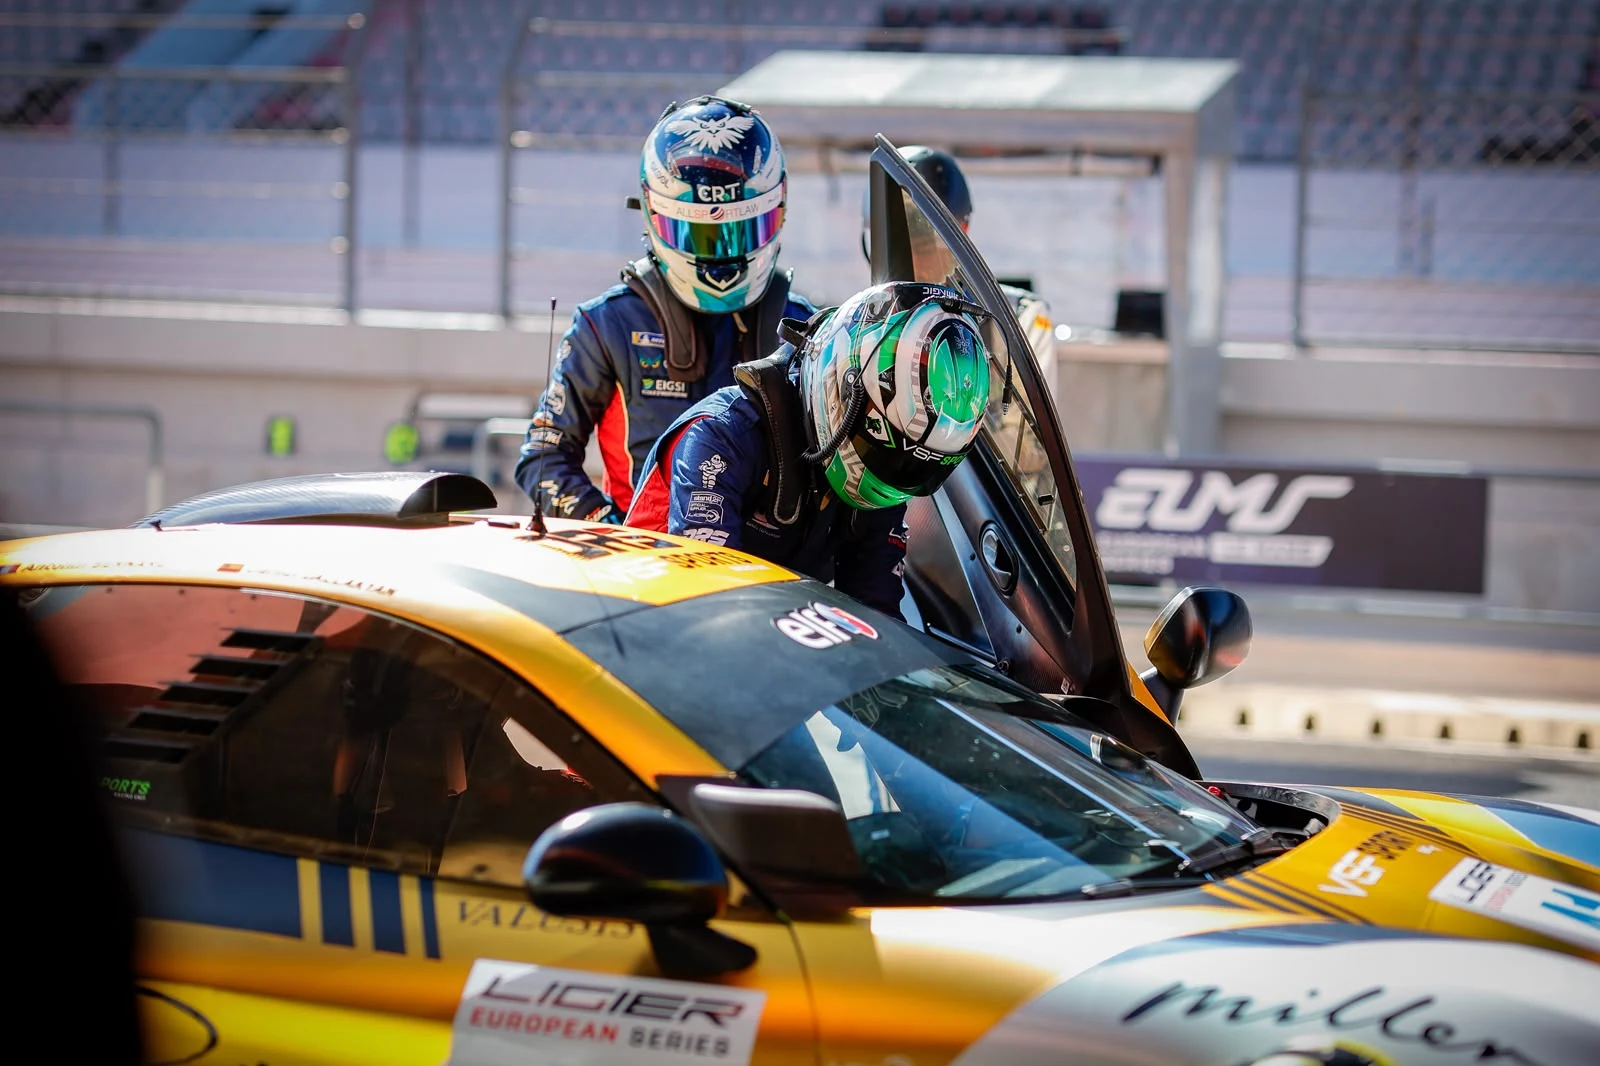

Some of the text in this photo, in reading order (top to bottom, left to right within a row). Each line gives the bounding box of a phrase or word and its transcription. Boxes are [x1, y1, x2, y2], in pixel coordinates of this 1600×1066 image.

[697, 182, 741, 202] CRT
[655, 379, 686, 392] EIGSI
[903, 438, 944, 461] VSF
[481, 976, 744, 1028] LIGIER
[469, 1006, 730, 1058] EUROPEAN SERIES
